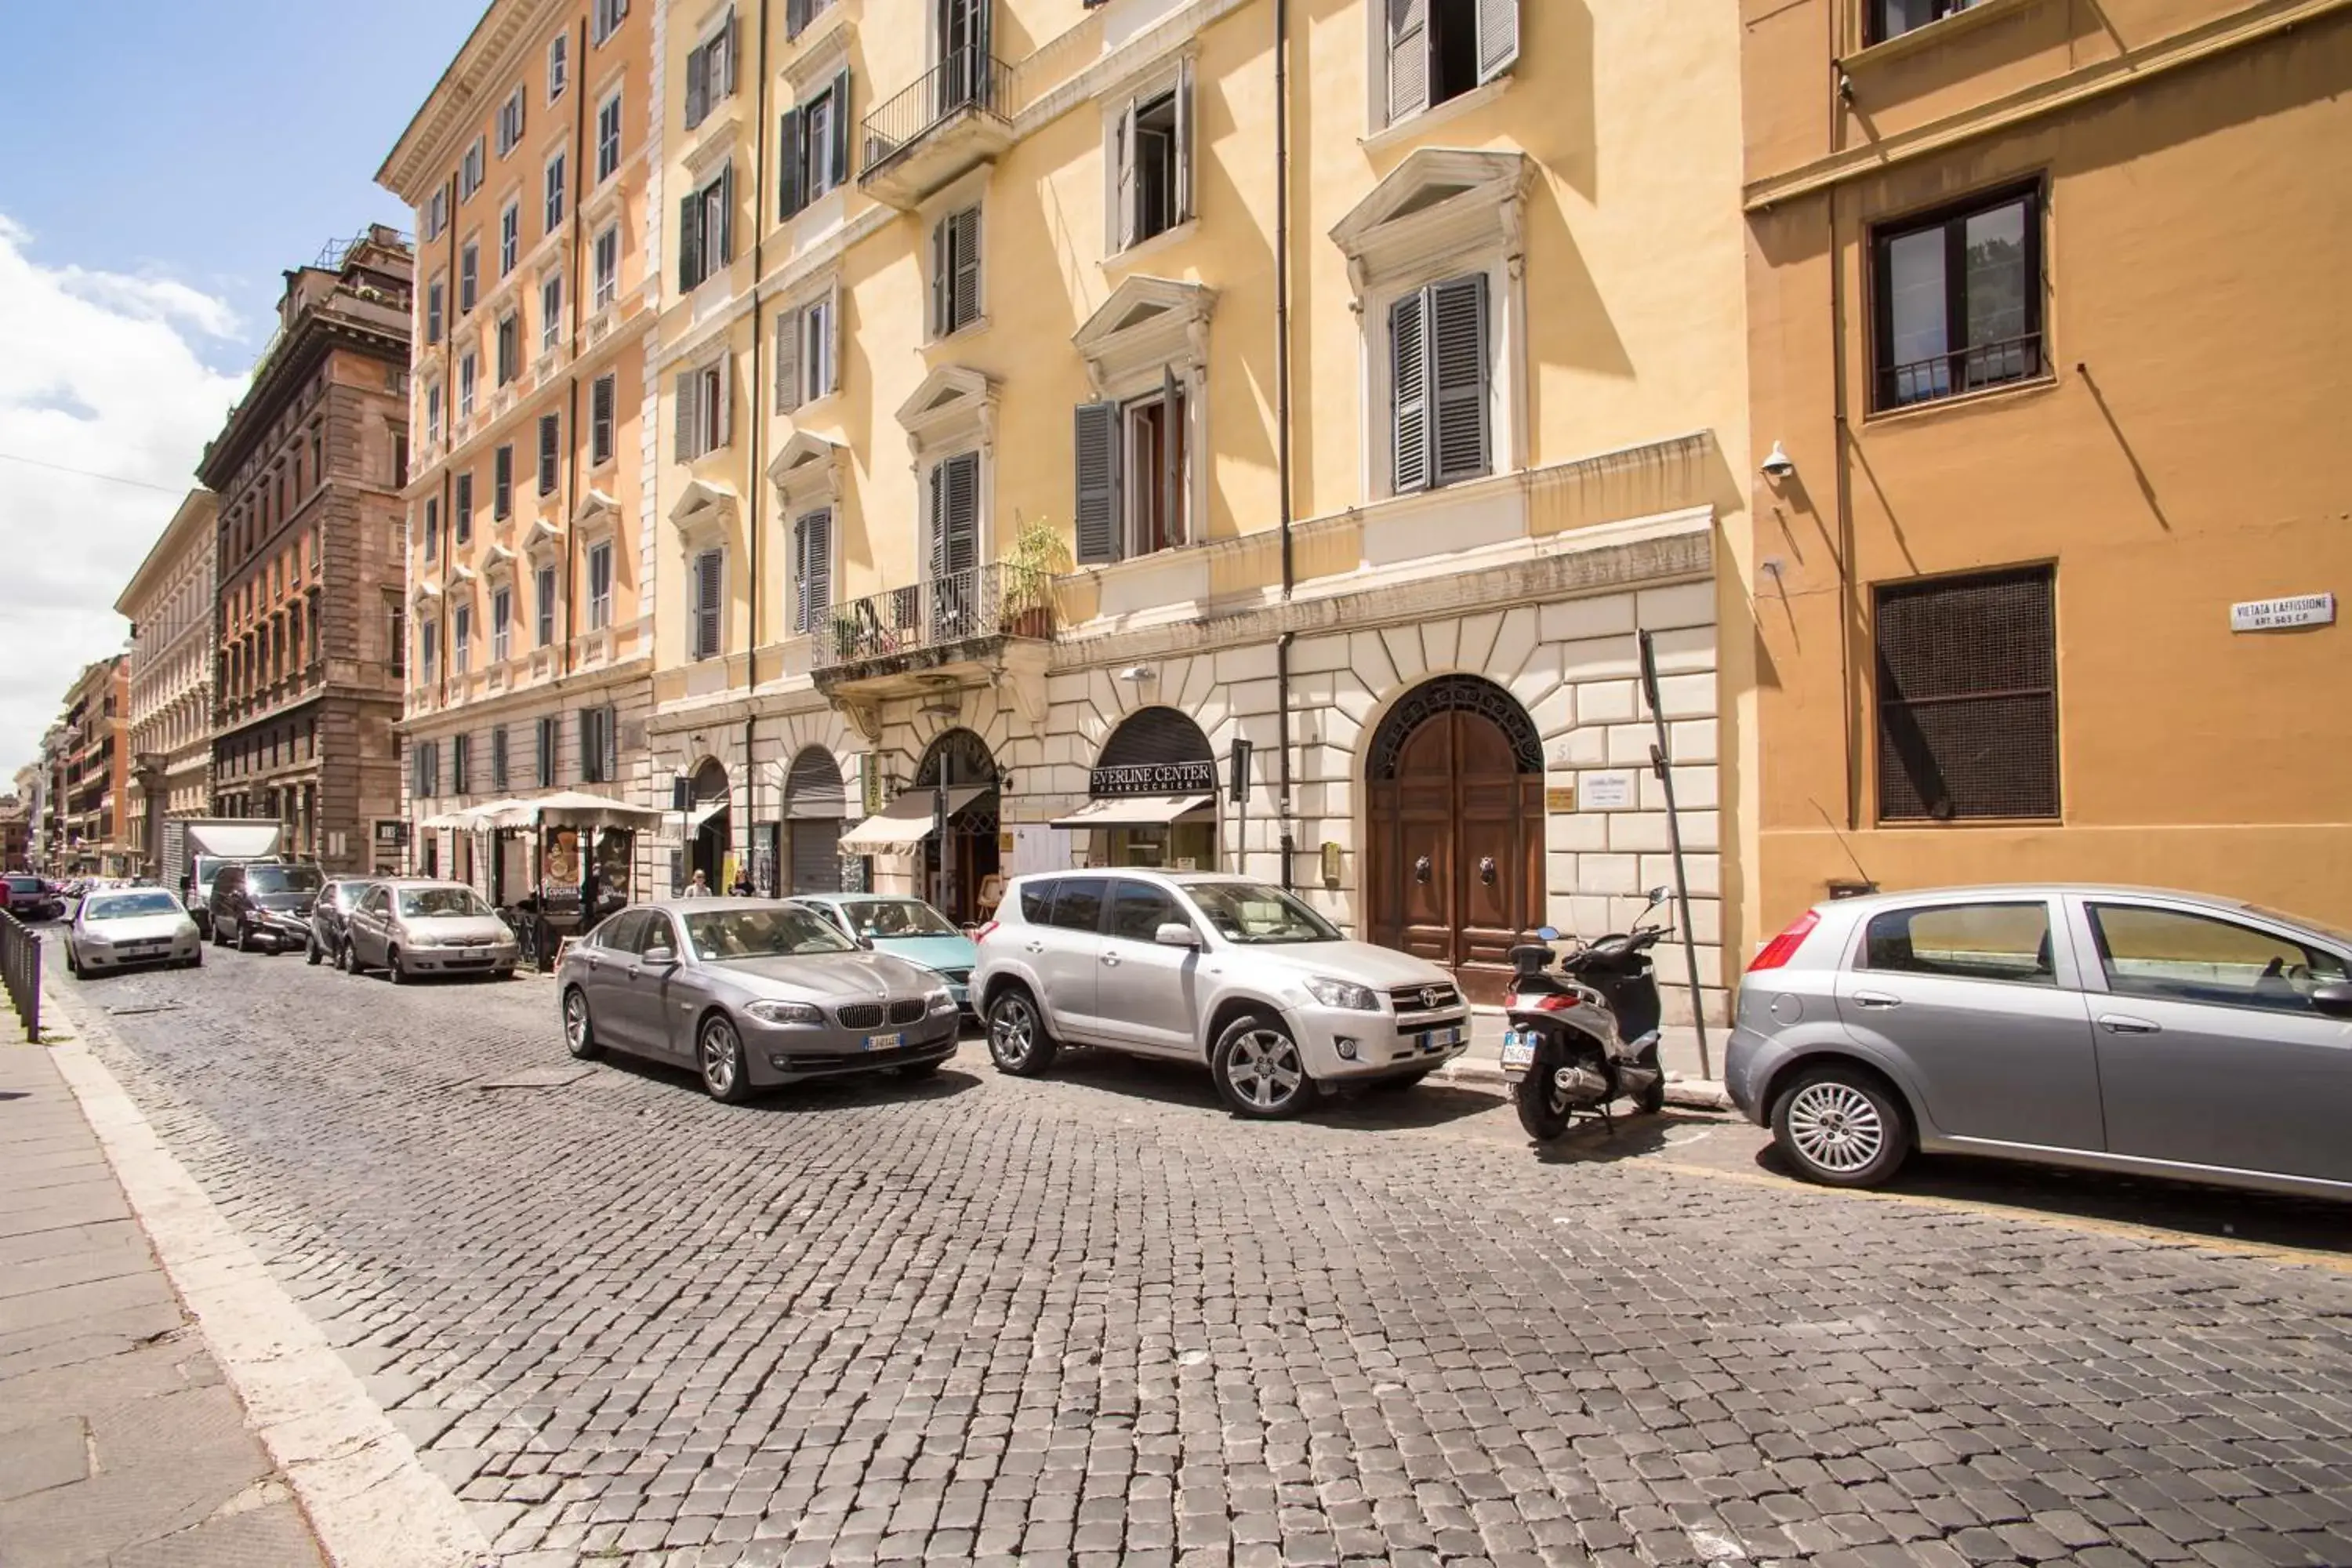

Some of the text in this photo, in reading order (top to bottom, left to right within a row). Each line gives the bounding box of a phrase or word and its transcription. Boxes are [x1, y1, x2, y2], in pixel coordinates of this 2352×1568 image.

[2237, 603, 2270, 617] VIETATA
[1093, 764, 1208, 784] EVERLINE CENTER
